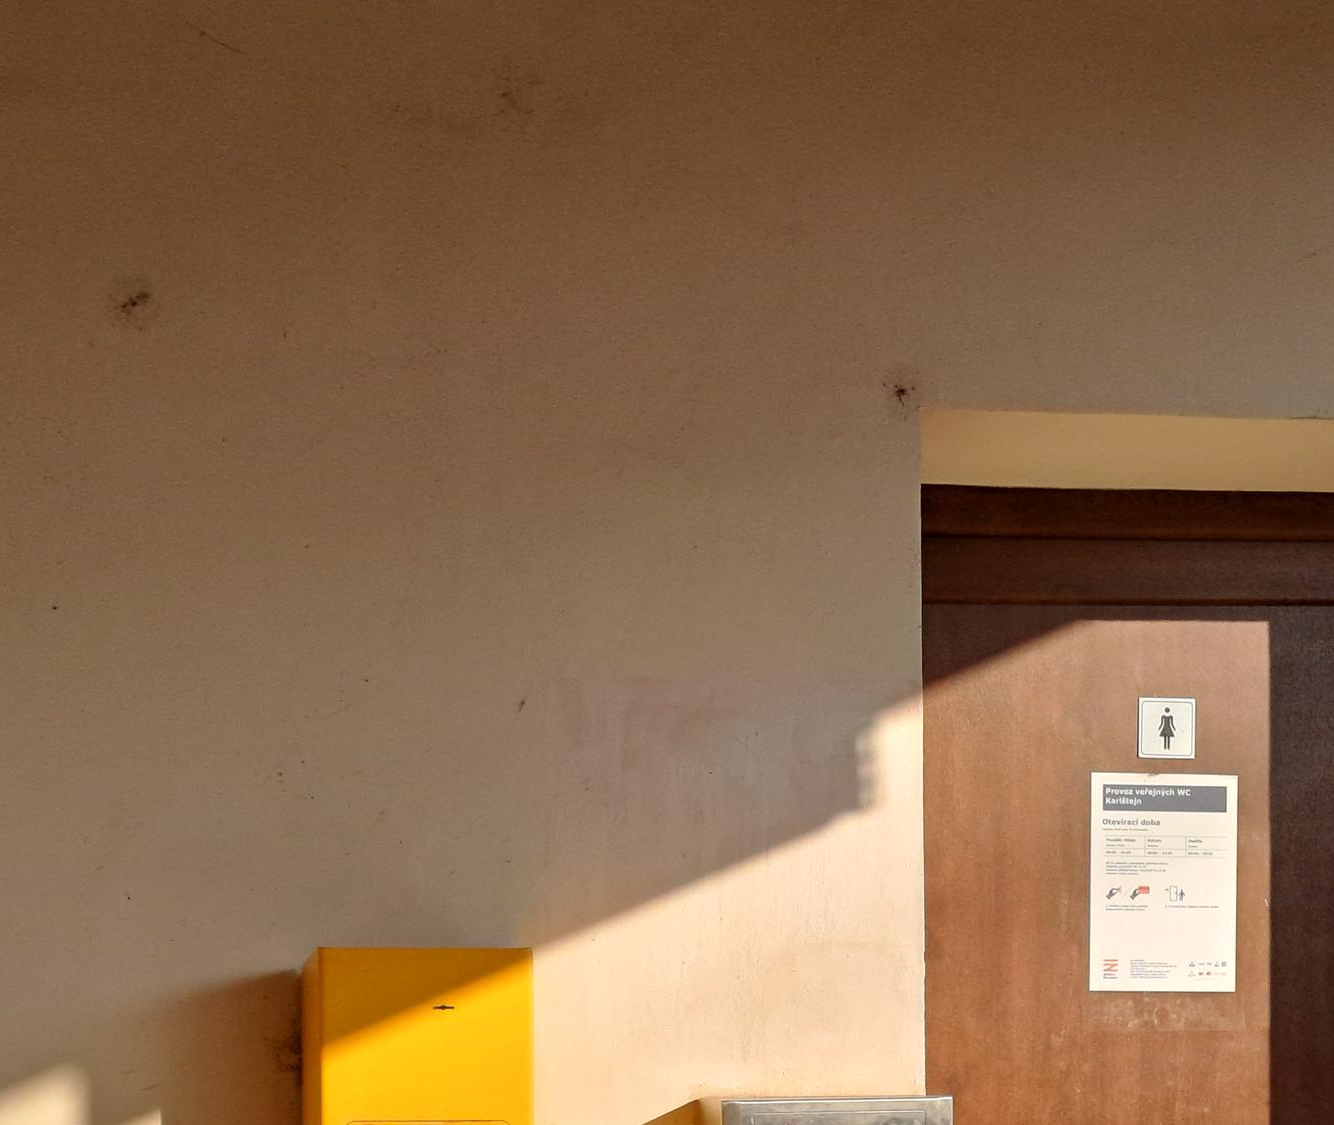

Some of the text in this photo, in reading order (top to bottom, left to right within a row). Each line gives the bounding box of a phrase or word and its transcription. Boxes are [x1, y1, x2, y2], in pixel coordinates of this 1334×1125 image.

[1105, 787, 1192, 798] Provoz veřejných WC
[1105, 796, 1143, 806] Karlštejn
[1140, 818, 1161, 826] doba
